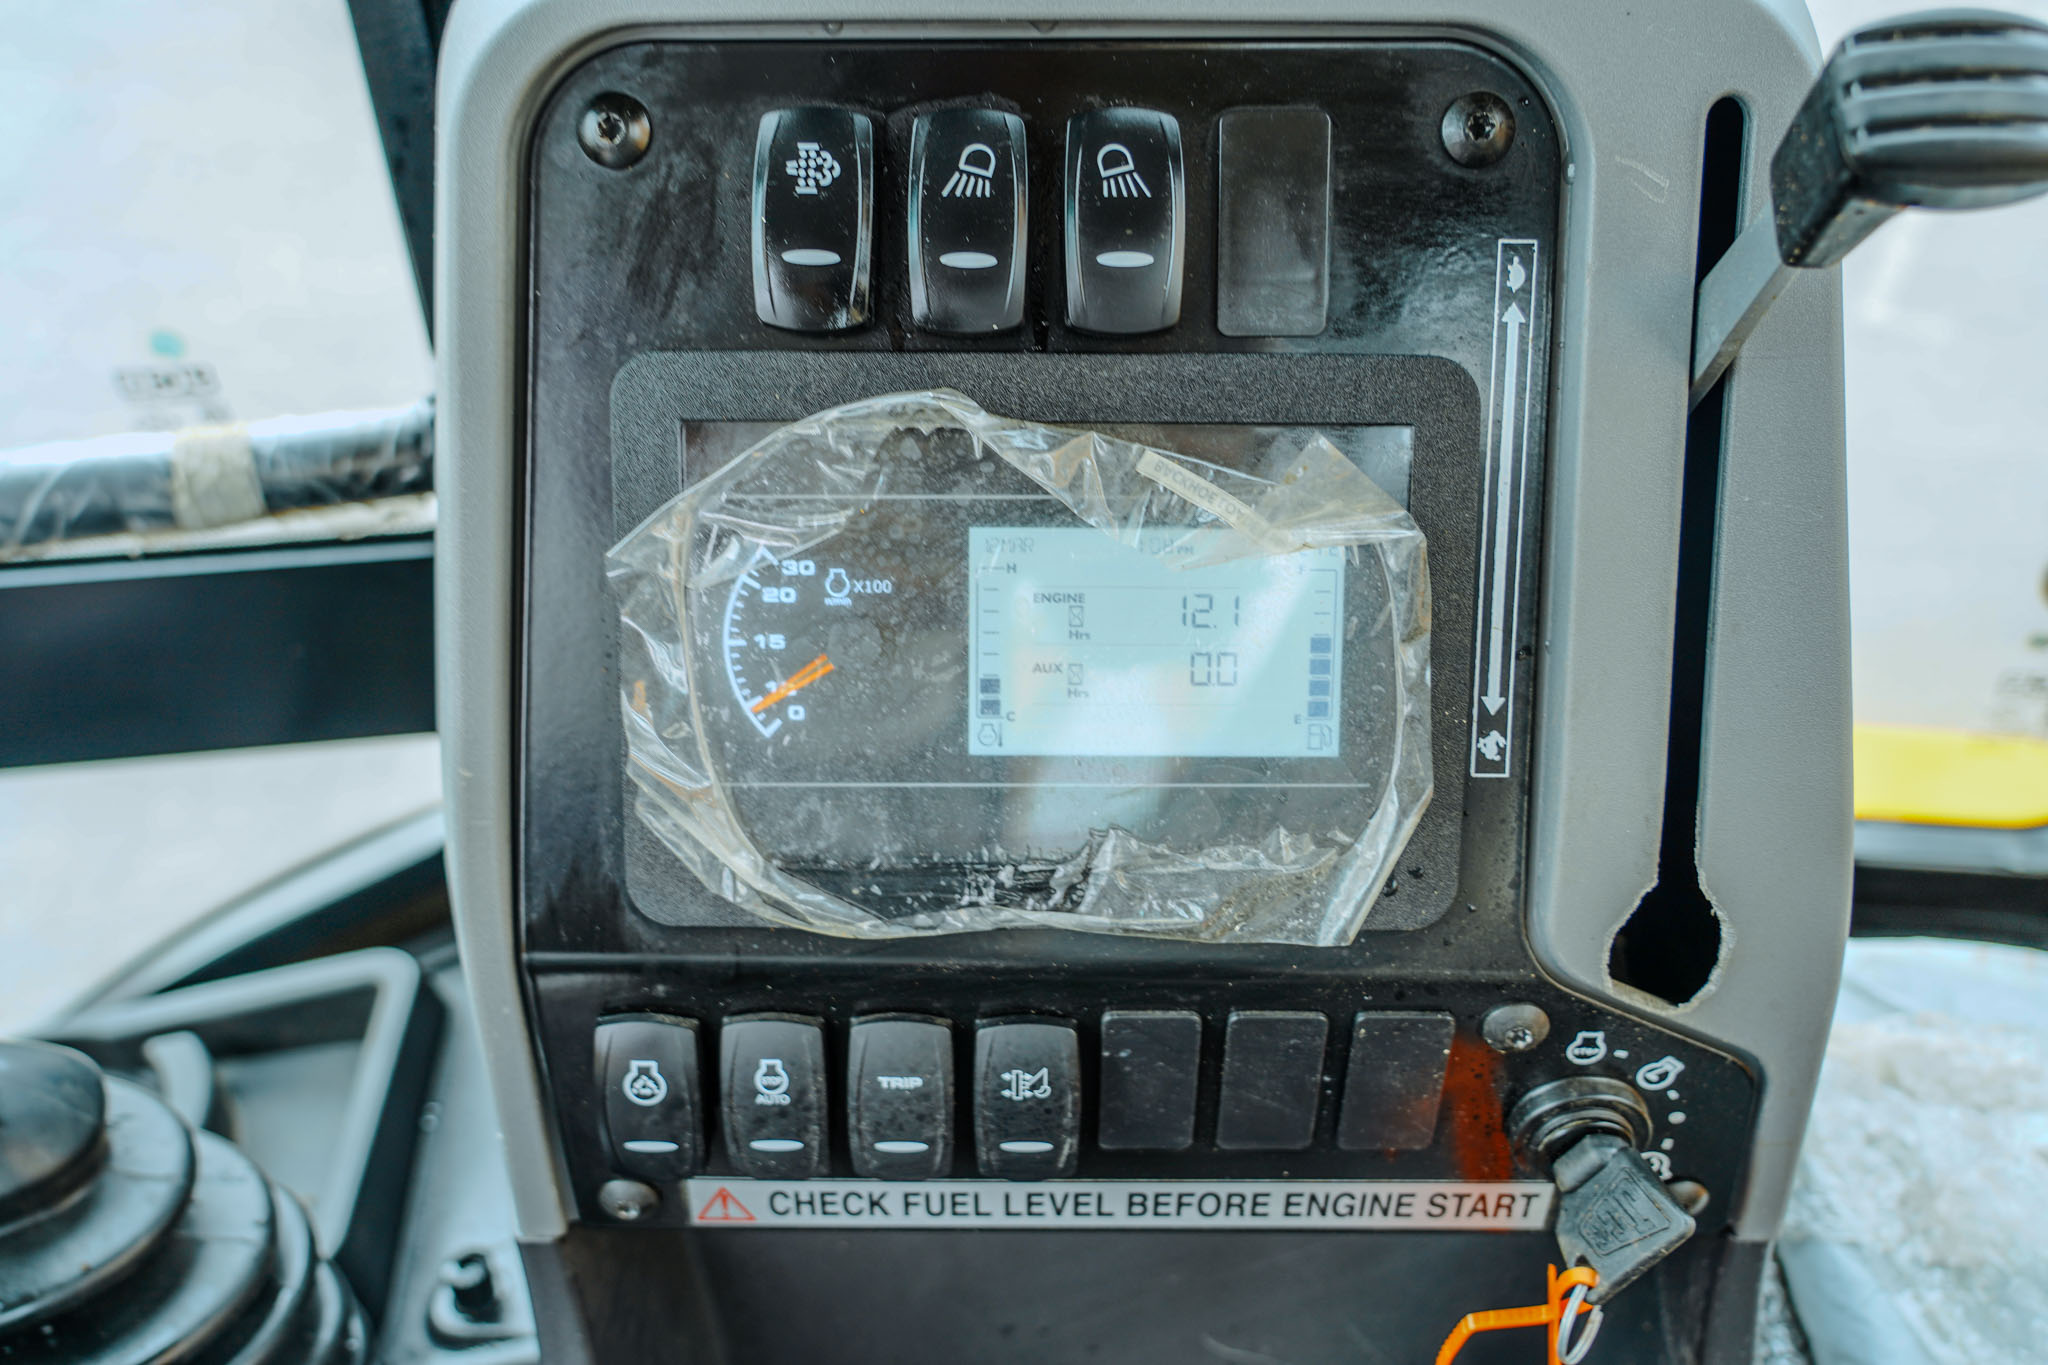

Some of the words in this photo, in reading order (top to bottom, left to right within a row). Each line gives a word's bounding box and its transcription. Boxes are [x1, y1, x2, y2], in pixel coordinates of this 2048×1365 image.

[781, 560, 816, 576] 30
[1006, 563, 1017, 574] H
[761, 587, 797, 603] 20
[1033, 593, 1086, 604] ENGINE
[754, 633, 787, 650] 15
[1068, 630, 1091, 640] Hrs
[1032, 662, 1064, 674] AUX
[1067, 687, 1090, 699] Hrs
[787, 704, 806, 721] 0
[876, 1075, 924, 1090] TRIP
[755, 1093, 791, 1105] AUTO
[769, 1191, 890, 1217] CHECK
[903, 1191, 993, 1217] FUEL
[1004, 1192, 1114, 1217] LEVEL
[1126, 1192, 1271, 1218] BEFORE
[1282, 1192, 1417, 1218] ENGINE
[1425, 1192, 1541, 1218] START
